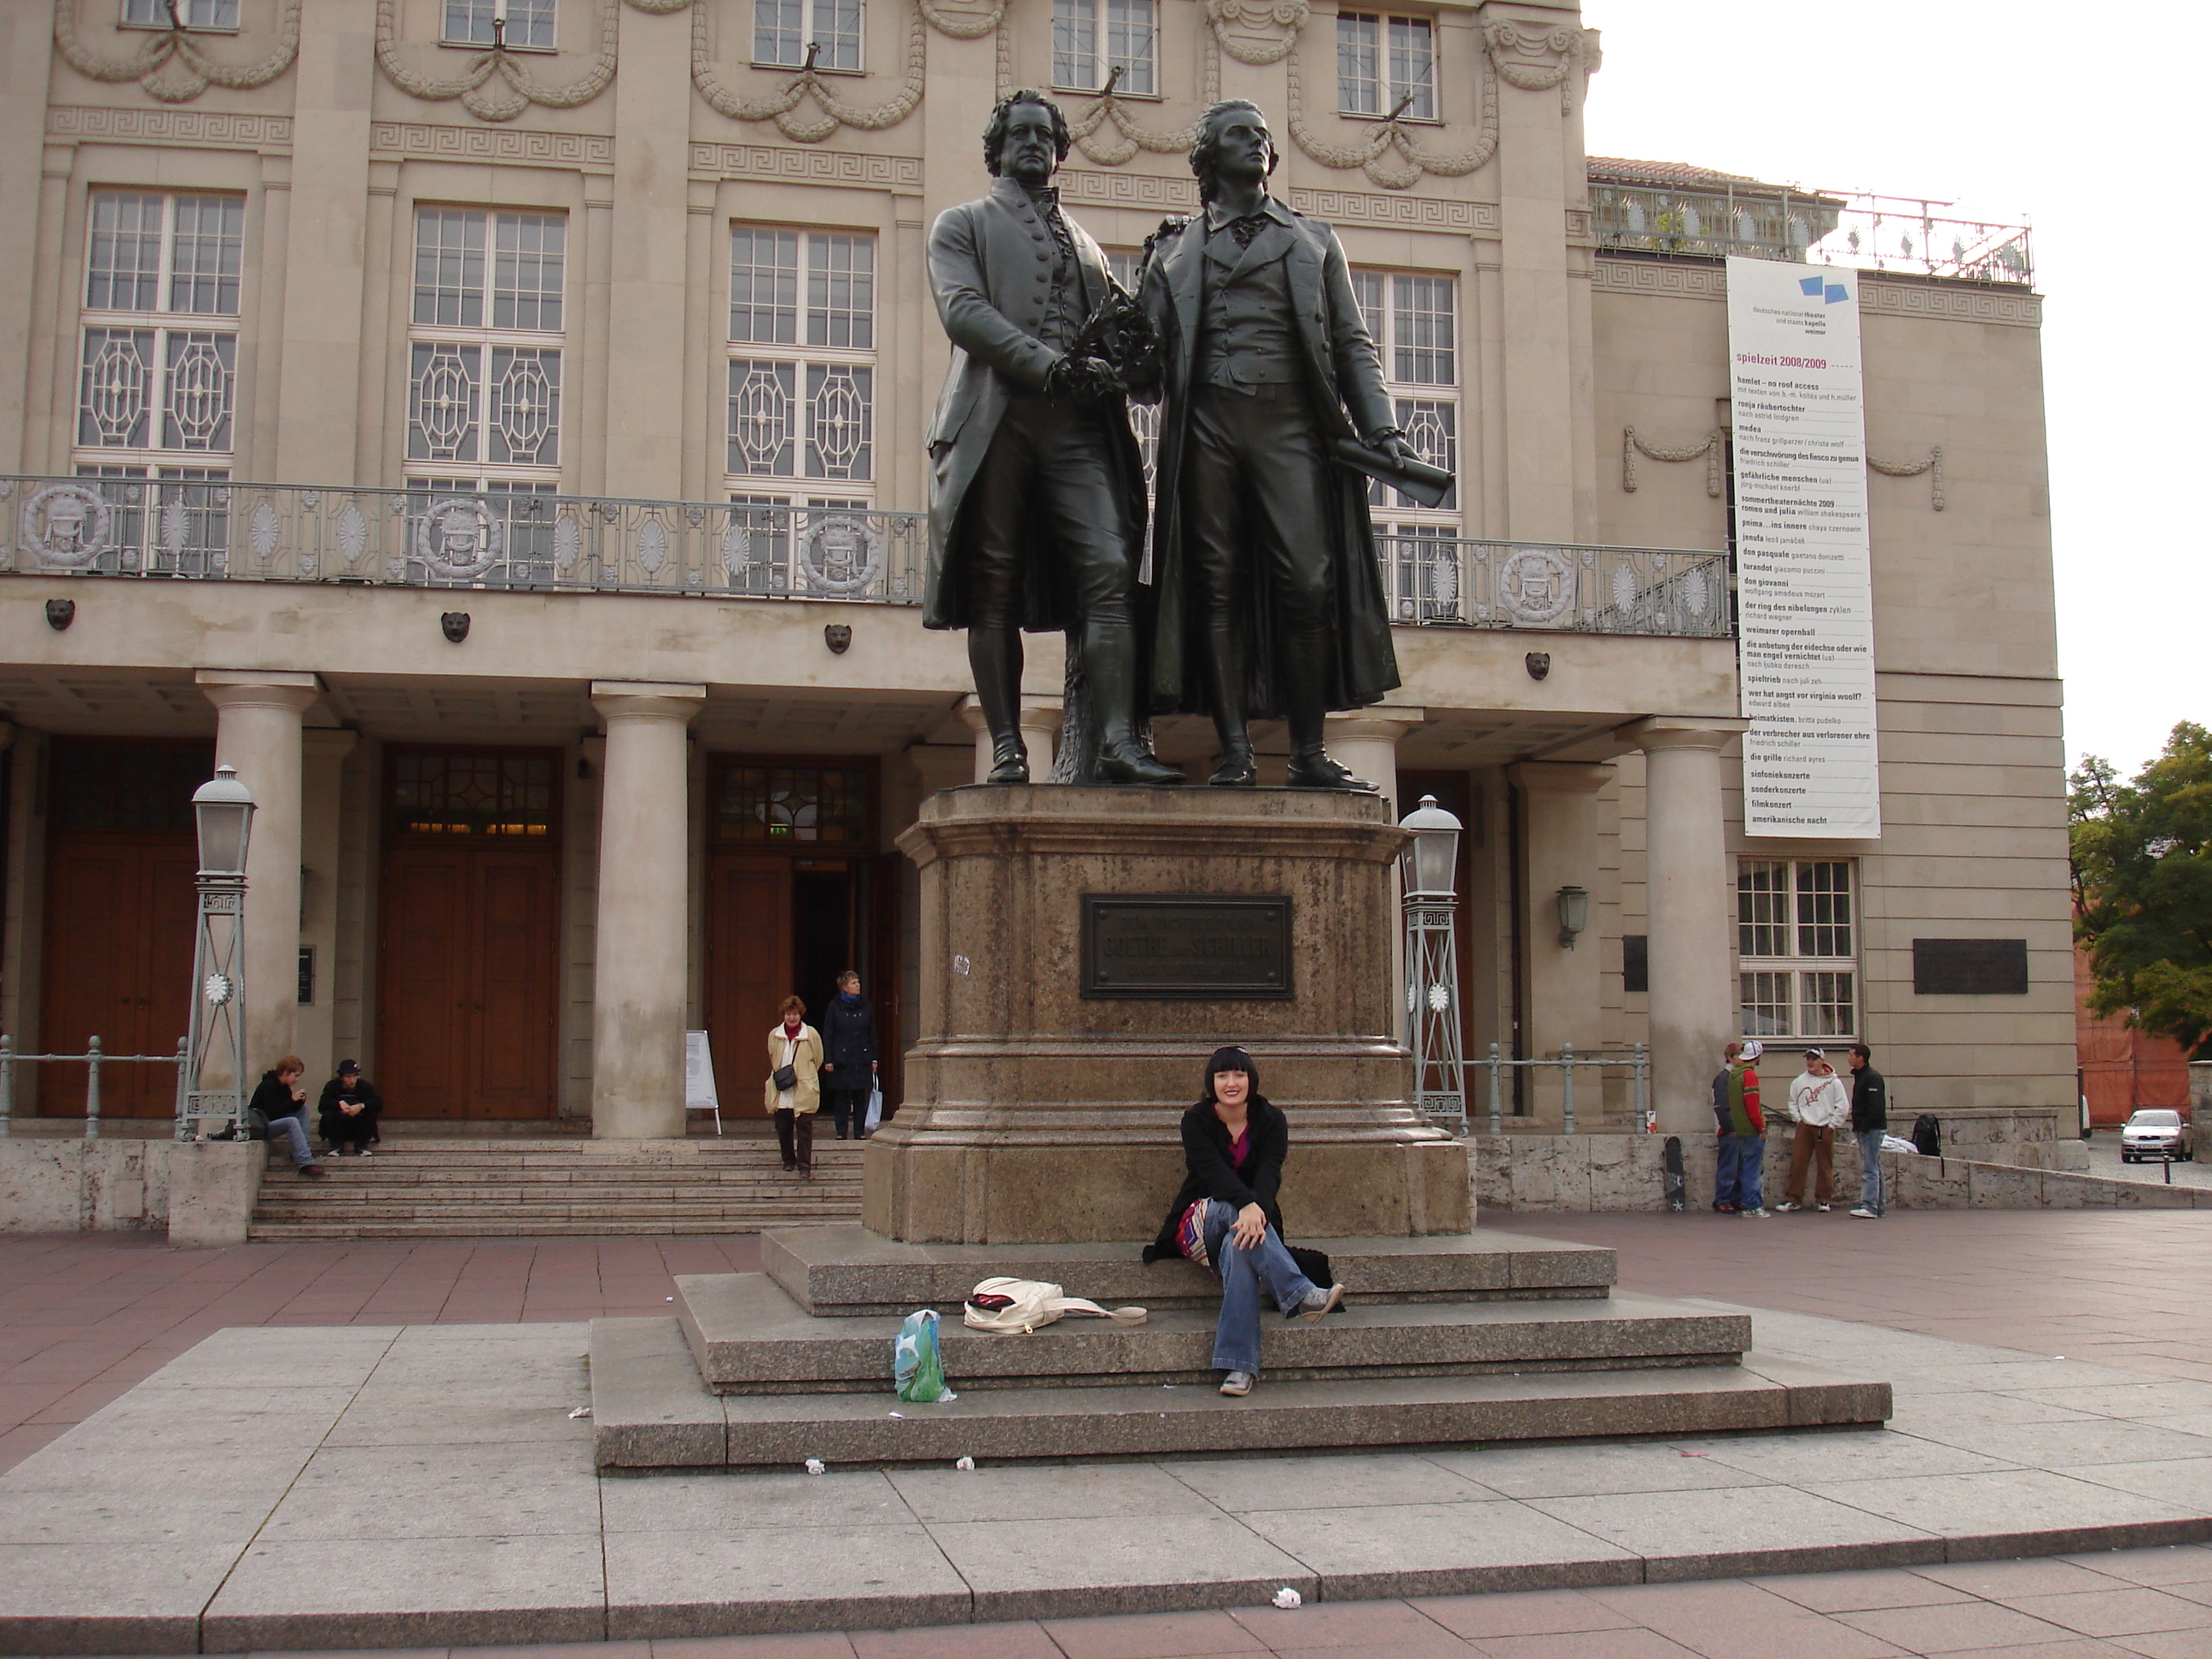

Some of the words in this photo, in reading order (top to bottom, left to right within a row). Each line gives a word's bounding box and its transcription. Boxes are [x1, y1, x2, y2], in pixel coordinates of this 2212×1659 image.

[1737, 352, 1777, 365] spielzeit
[1780, 357, 1826, 369] 2008/2009
[1738, 376, 1761, 385] hamlet
[1738, 401, 1755, 410] ronja
[1757, 402, 1805, 412] räubertochter
[1773, 437, 1803, 445] grillparzer
[1750, 451, 1796, 460] verschwörung
[1740, 458, 1765, 467] friedrich
[1741, 472, 1779, 481] gefährliche
[1741, 481, 1778, 491] jörg-michael
[1742, 496, 1817, 507] sommertheaternächte
[1779, 508, 1796, 516] julia
[1743, 533, 1763, 542] jenufa
[1743, 563, 1772, 572] turandot
[1758, 603, 1772, 612] ring
[1788, 604, 1827, 614] nibelungen
[1746, 626, 1778, 635] weimarer
[1758, 642, 1790, 651] anbetung
[1763, 652, 1782, 661] engel
[1748, 675, 1781, 684] spieltrieb
[1776, 691, 1795, 700] angst
[1810, 692, 1836, 701] virginia
[1763, 754, 1782, 762] grille
[1751, 771, 1810, 779] sinfoniekonzerte
[1752, 800, 1791, 808] filmkonzert
[1103, 935, 1168, 957] GOETHE
[1191, 935, 1271, 958] SCHILLER
